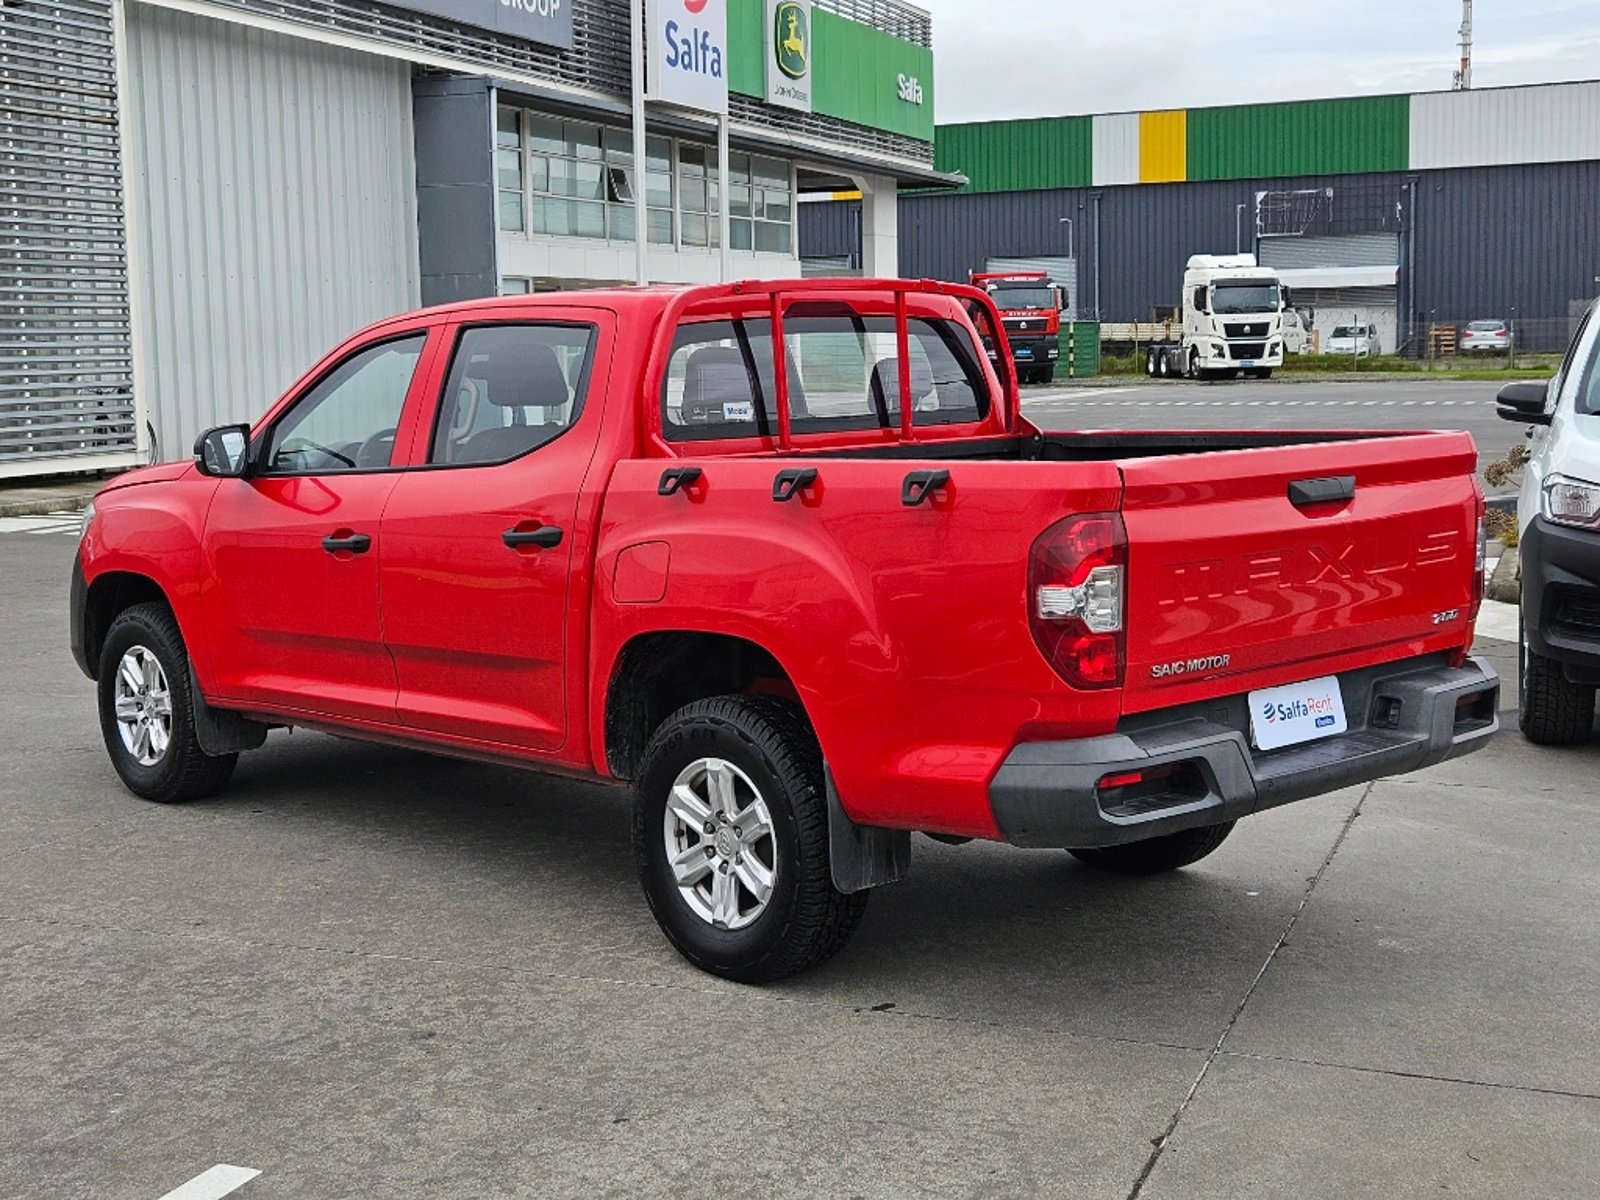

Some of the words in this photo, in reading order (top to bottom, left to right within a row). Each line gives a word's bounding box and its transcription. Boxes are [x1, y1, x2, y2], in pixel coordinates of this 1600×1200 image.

[501, 0, 560, 18] OUP
[665, 20, 722, 79] Salfa
[897, 72, 923, 105] Salfa
[1151, 660, 1186, 678] SAIC
[1186, 654, 1231, 672] MOTOR
[1277, 695, 1333, 721] SalfaRent
